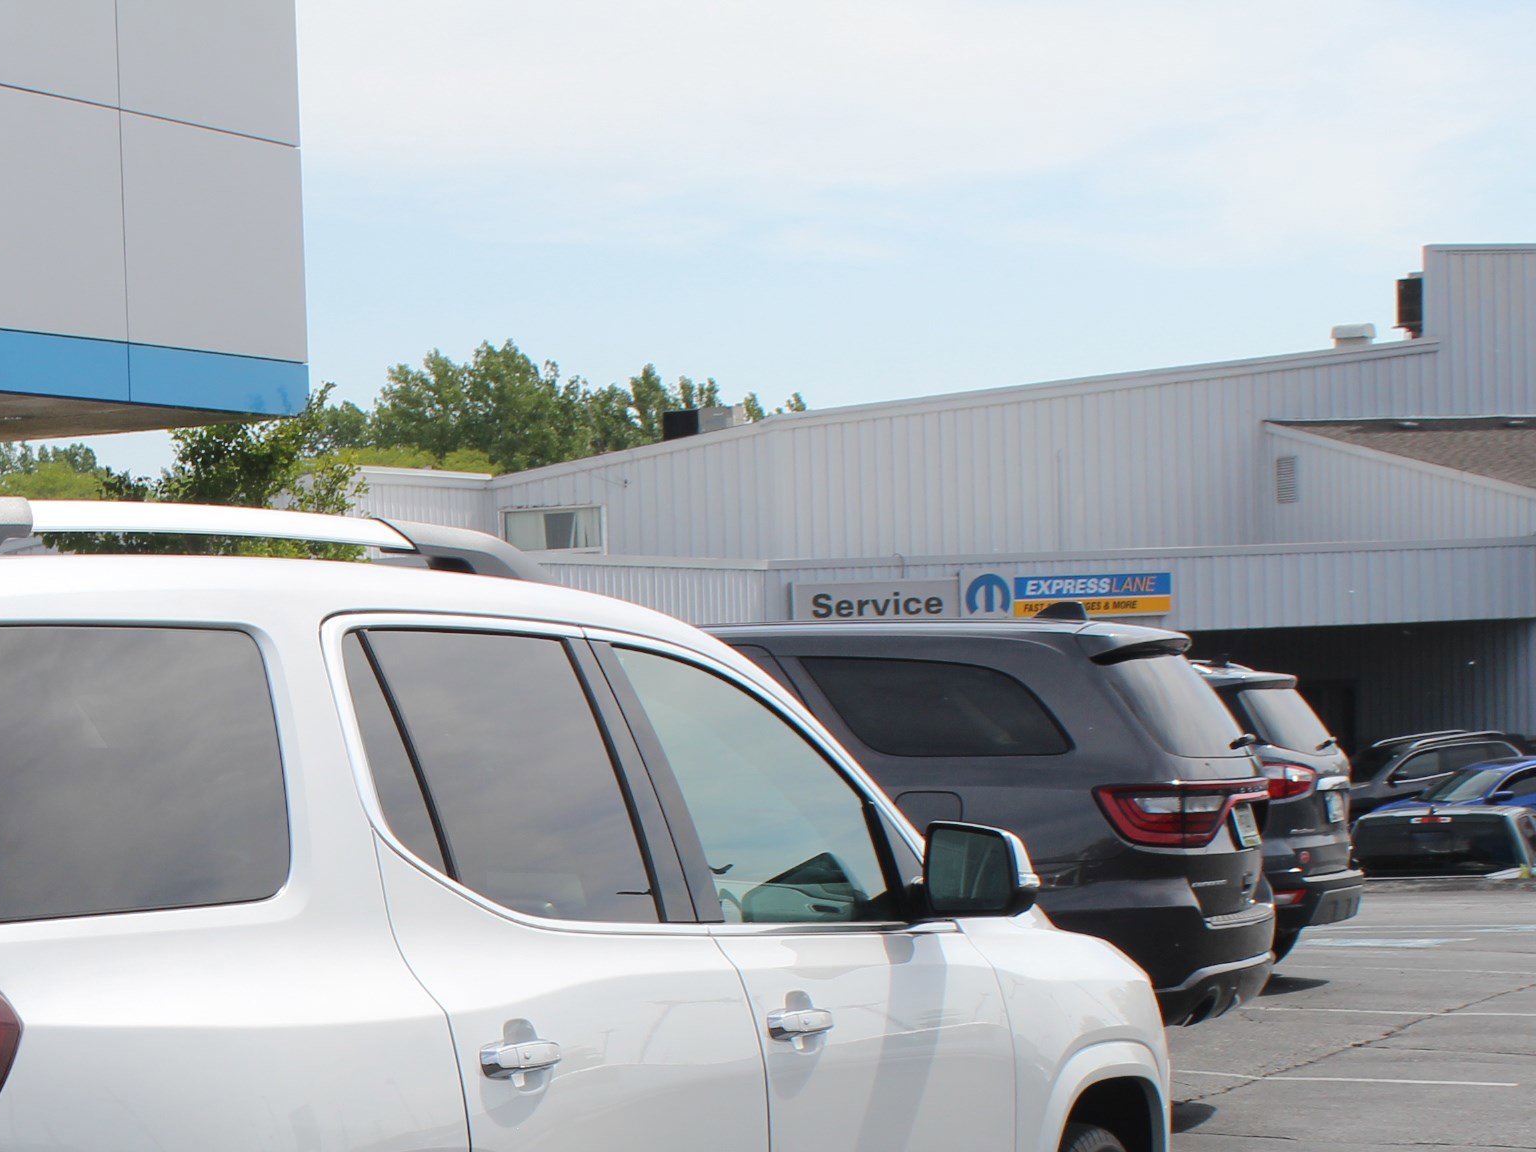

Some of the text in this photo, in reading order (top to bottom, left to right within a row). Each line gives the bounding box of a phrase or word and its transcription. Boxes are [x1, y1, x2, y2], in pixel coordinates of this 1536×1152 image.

[811, 592, 943, 619] Service
[1023, 603, 1044, 613] FAST
[1114, 601, 1137, 611] MORE
